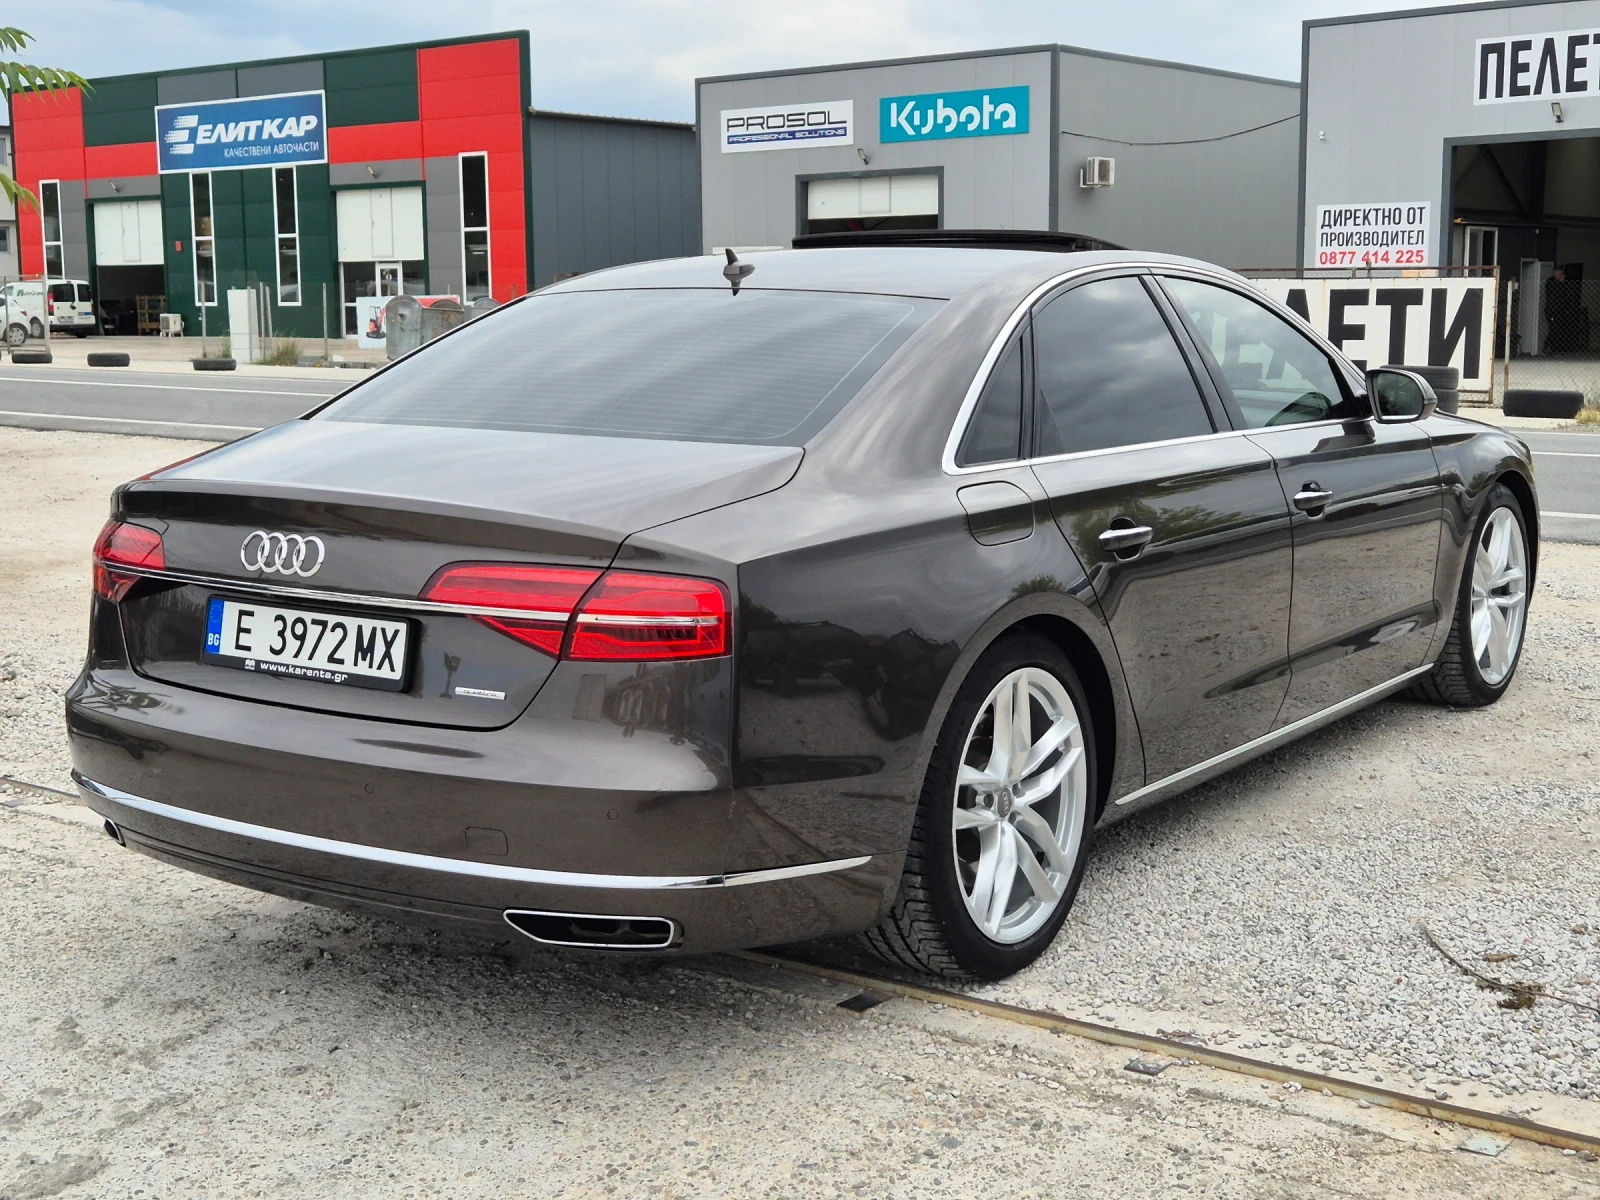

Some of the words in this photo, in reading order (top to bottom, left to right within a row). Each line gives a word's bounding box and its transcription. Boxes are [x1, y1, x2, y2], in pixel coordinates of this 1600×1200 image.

[1479, 33, 1600, 100] ПЕЛЕ
[727, 110, 847, 132] PROSOL
[890, 95, 1017, 136] Kubota
[196, 115, 318, 144] ЕЛИТКАР
[729, 133, 793, 143] PROFESSIONAL
[795, 129, 845, 137] SOLUTIONS
[224, 145, 271, 158] КАЧЕСТВЕНИ
[273, 141, 319, 155] АВТОЧАСТИ
[1320, 207, 1402, 229] ДИРЕКТНО
[1406, 206, 1426, 225] ОТ
[1320, 229, 1425, 247] ПРОИЗВОДИТЕЛ
[1319, 251, 1356, 265] 0877
[1361, 250, 1390, 264] 414
[1395, 249, 1424, 263] 225
[207, 633, 220, 646] BG
[269, 614, 348, 665] 3972
[260, 661, 348, 682] www.karenta.gr
